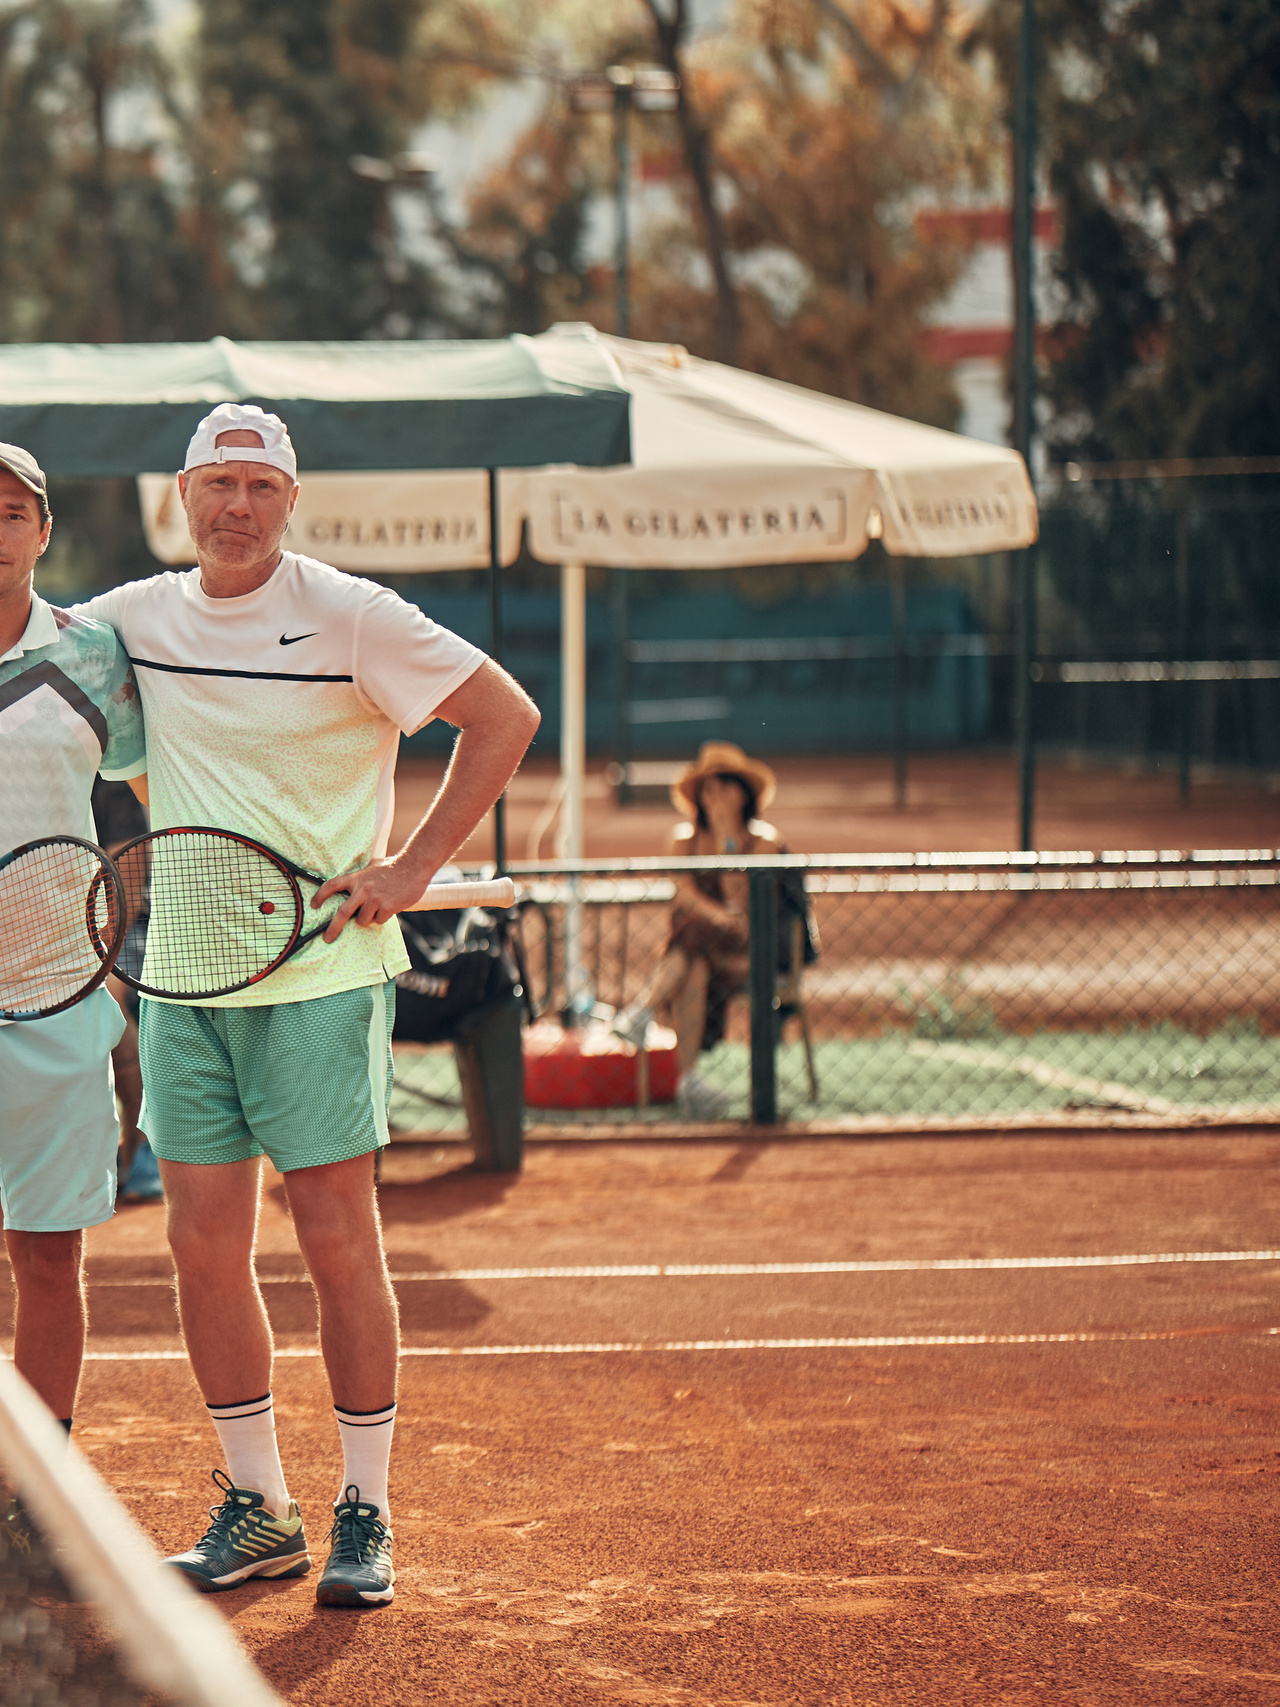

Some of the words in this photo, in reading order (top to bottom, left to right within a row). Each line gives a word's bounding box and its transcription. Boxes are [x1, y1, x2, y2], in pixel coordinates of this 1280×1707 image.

[305, 514, 478, 548] GELATERIA
[572, 505, 612, 537] LA
[621, 502, 825, 541] GELATERIA
